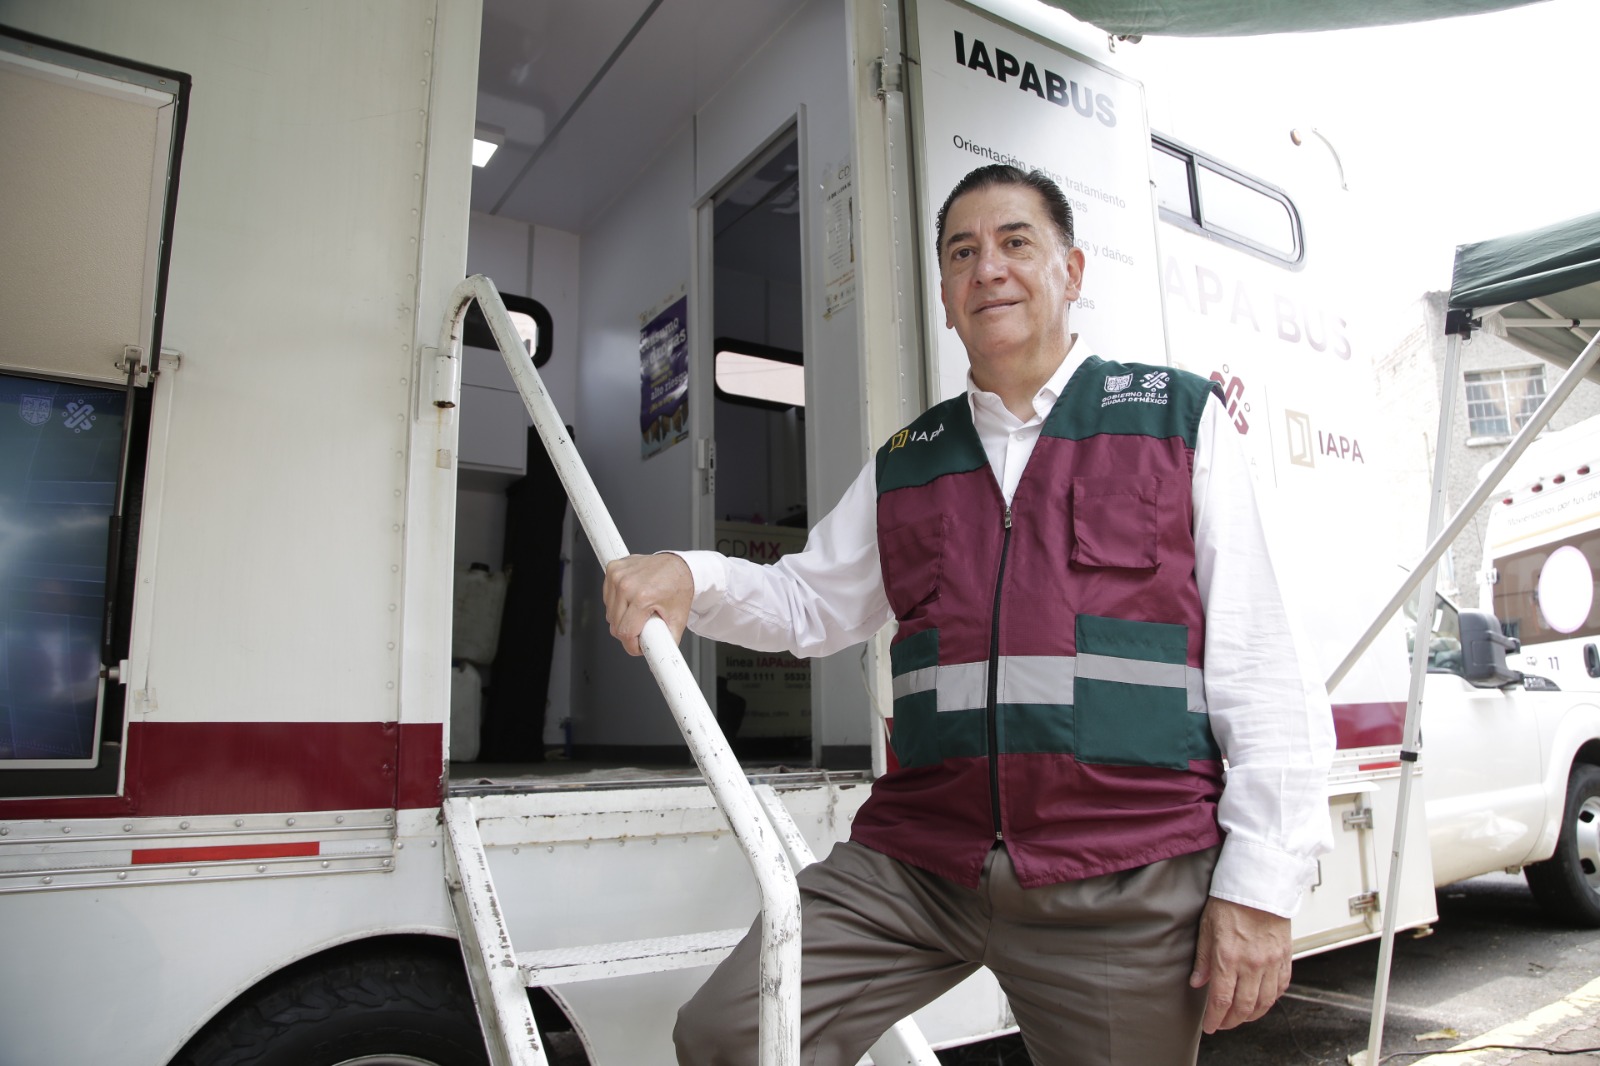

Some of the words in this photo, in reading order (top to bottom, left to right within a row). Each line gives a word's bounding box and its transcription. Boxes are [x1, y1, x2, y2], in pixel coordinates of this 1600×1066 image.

[954, 30, 1117, 129] IAPABUS
[953, 134, 1026, 171] Orientación
[1065, 175, 1126, 209] tratamiento
[1092, 242, 1099, 256] y
[1101, 243, 1134, 266] daños
[1273, 290, 1351, 361] BUS
[1101, 391, 1143, 403] GOBIERNO
[1101, 397, 1127, 408] CIUDAD
[911, 422, 945, 442] IAPA
[1318, 430, 1364, 464] IAPA
[716, 539, 782, 560] CDMX
[1548, 656, 1560, 671] 11
[753, 672, 775, 681] 1111
